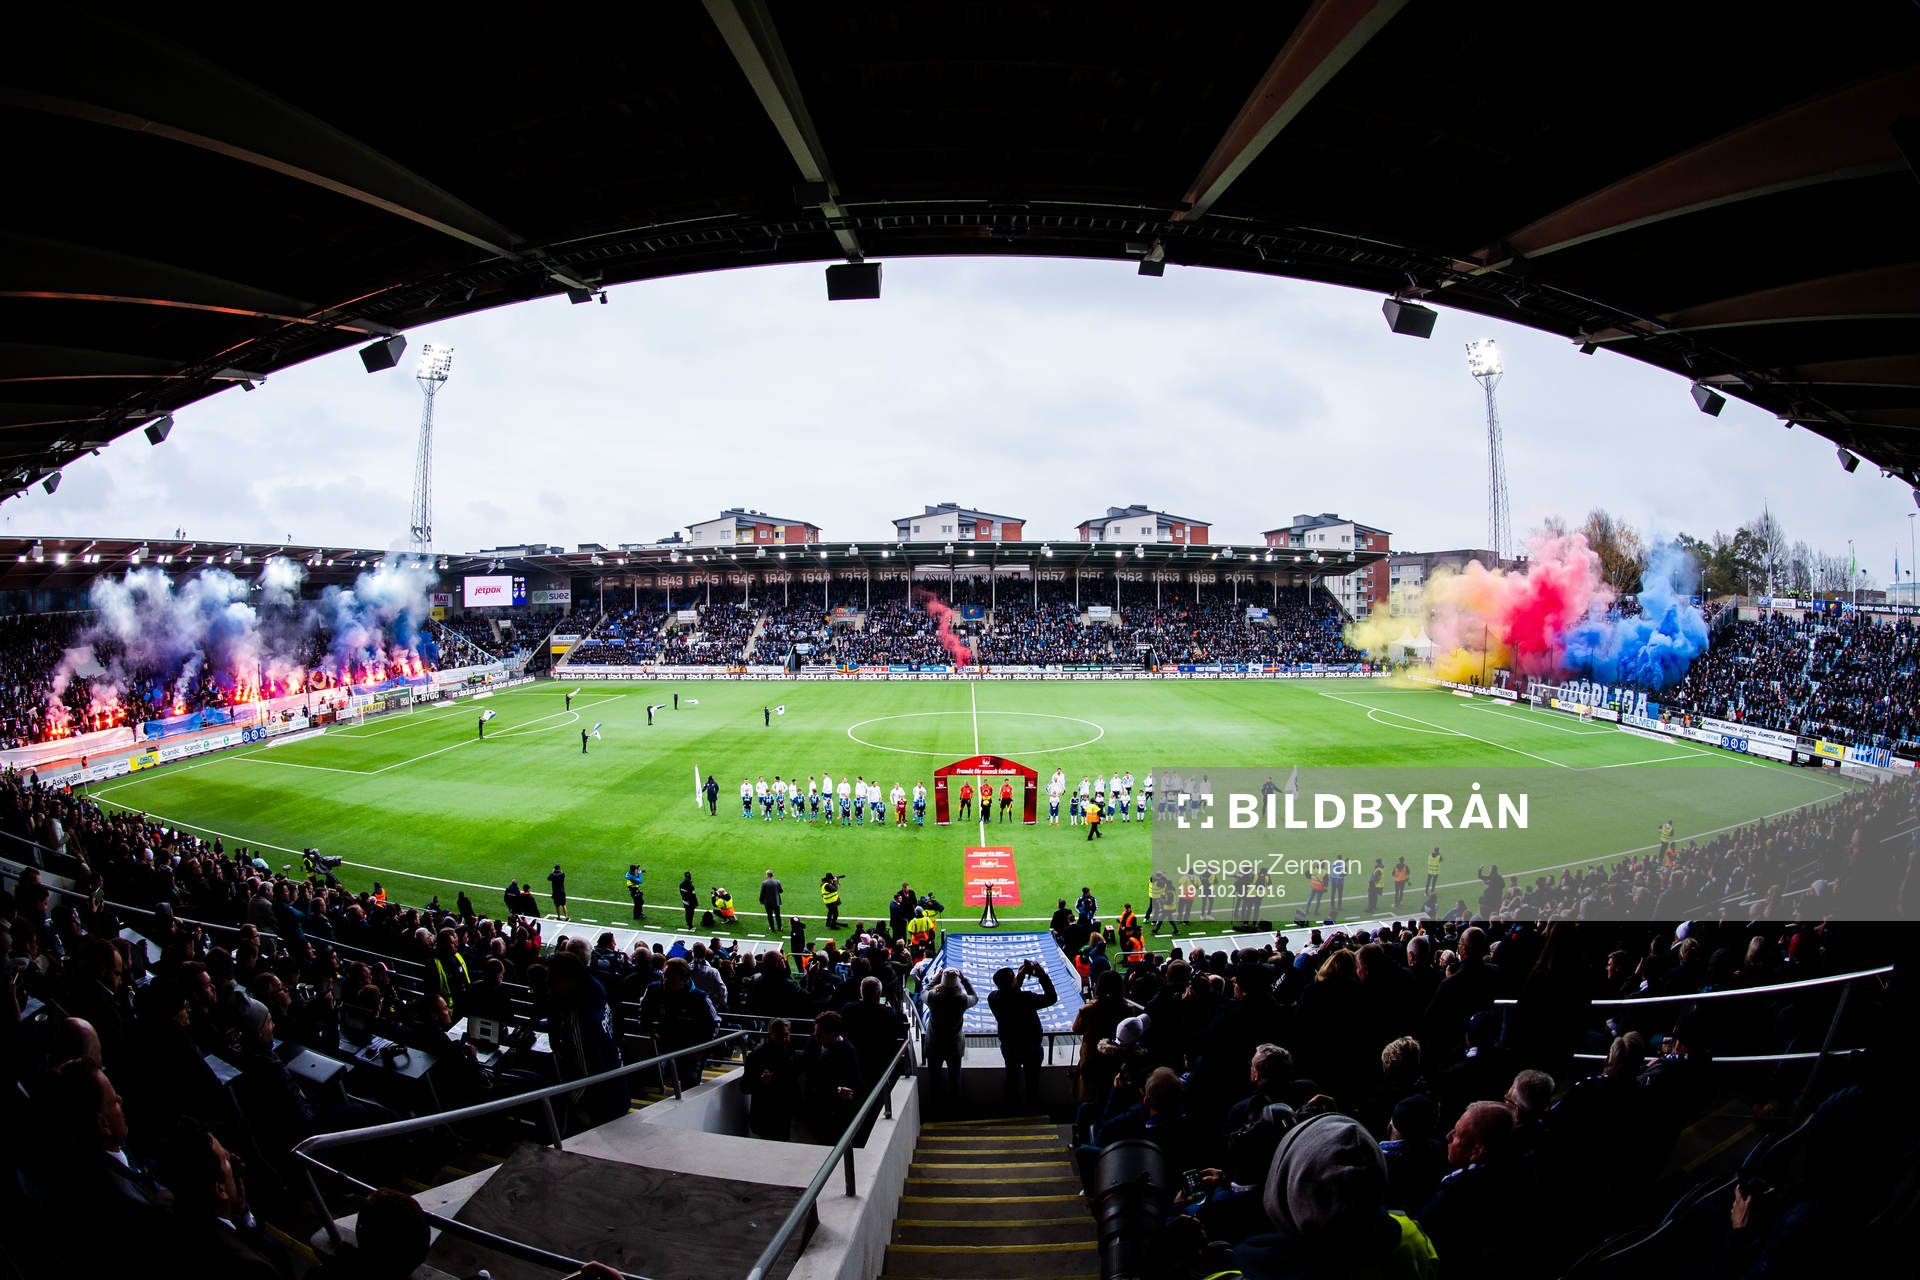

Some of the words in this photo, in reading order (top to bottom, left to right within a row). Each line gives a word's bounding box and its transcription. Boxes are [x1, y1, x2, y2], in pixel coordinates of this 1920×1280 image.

[657, 576, 683, 585] 1943
[1189, 573, 1216, 583] 1989
[1043, 672, 1071, 680] stadium
[1624, 714, 1657, 729] HOLMEN
